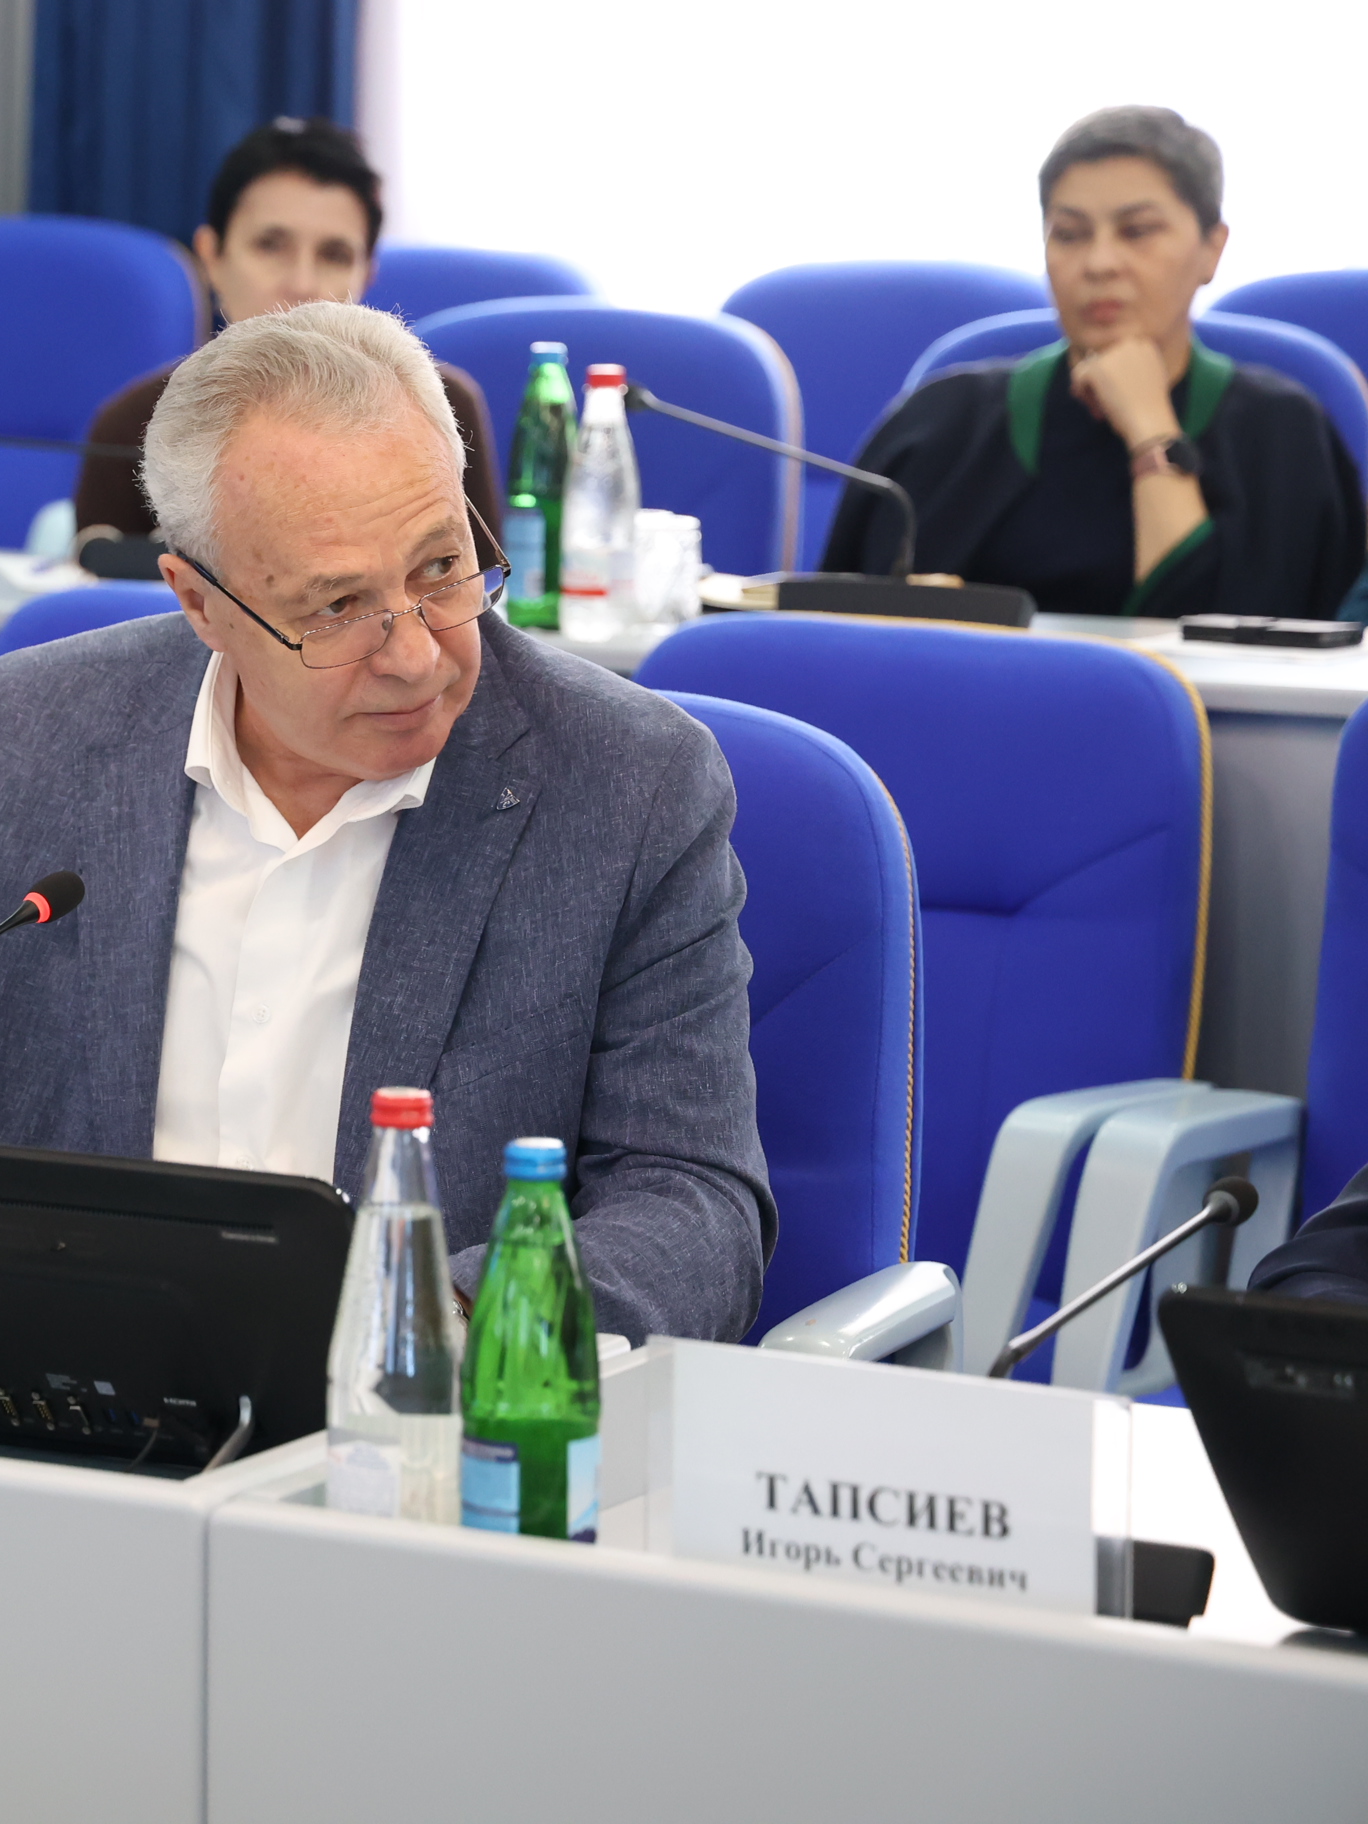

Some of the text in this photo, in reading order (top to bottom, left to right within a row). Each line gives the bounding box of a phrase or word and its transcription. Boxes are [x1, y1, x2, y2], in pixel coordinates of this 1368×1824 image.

[755, 1470, 1011, 1541] ТАПСИЕВ
[741, 1526, 1029, 1592] Игорь Сергеевич
